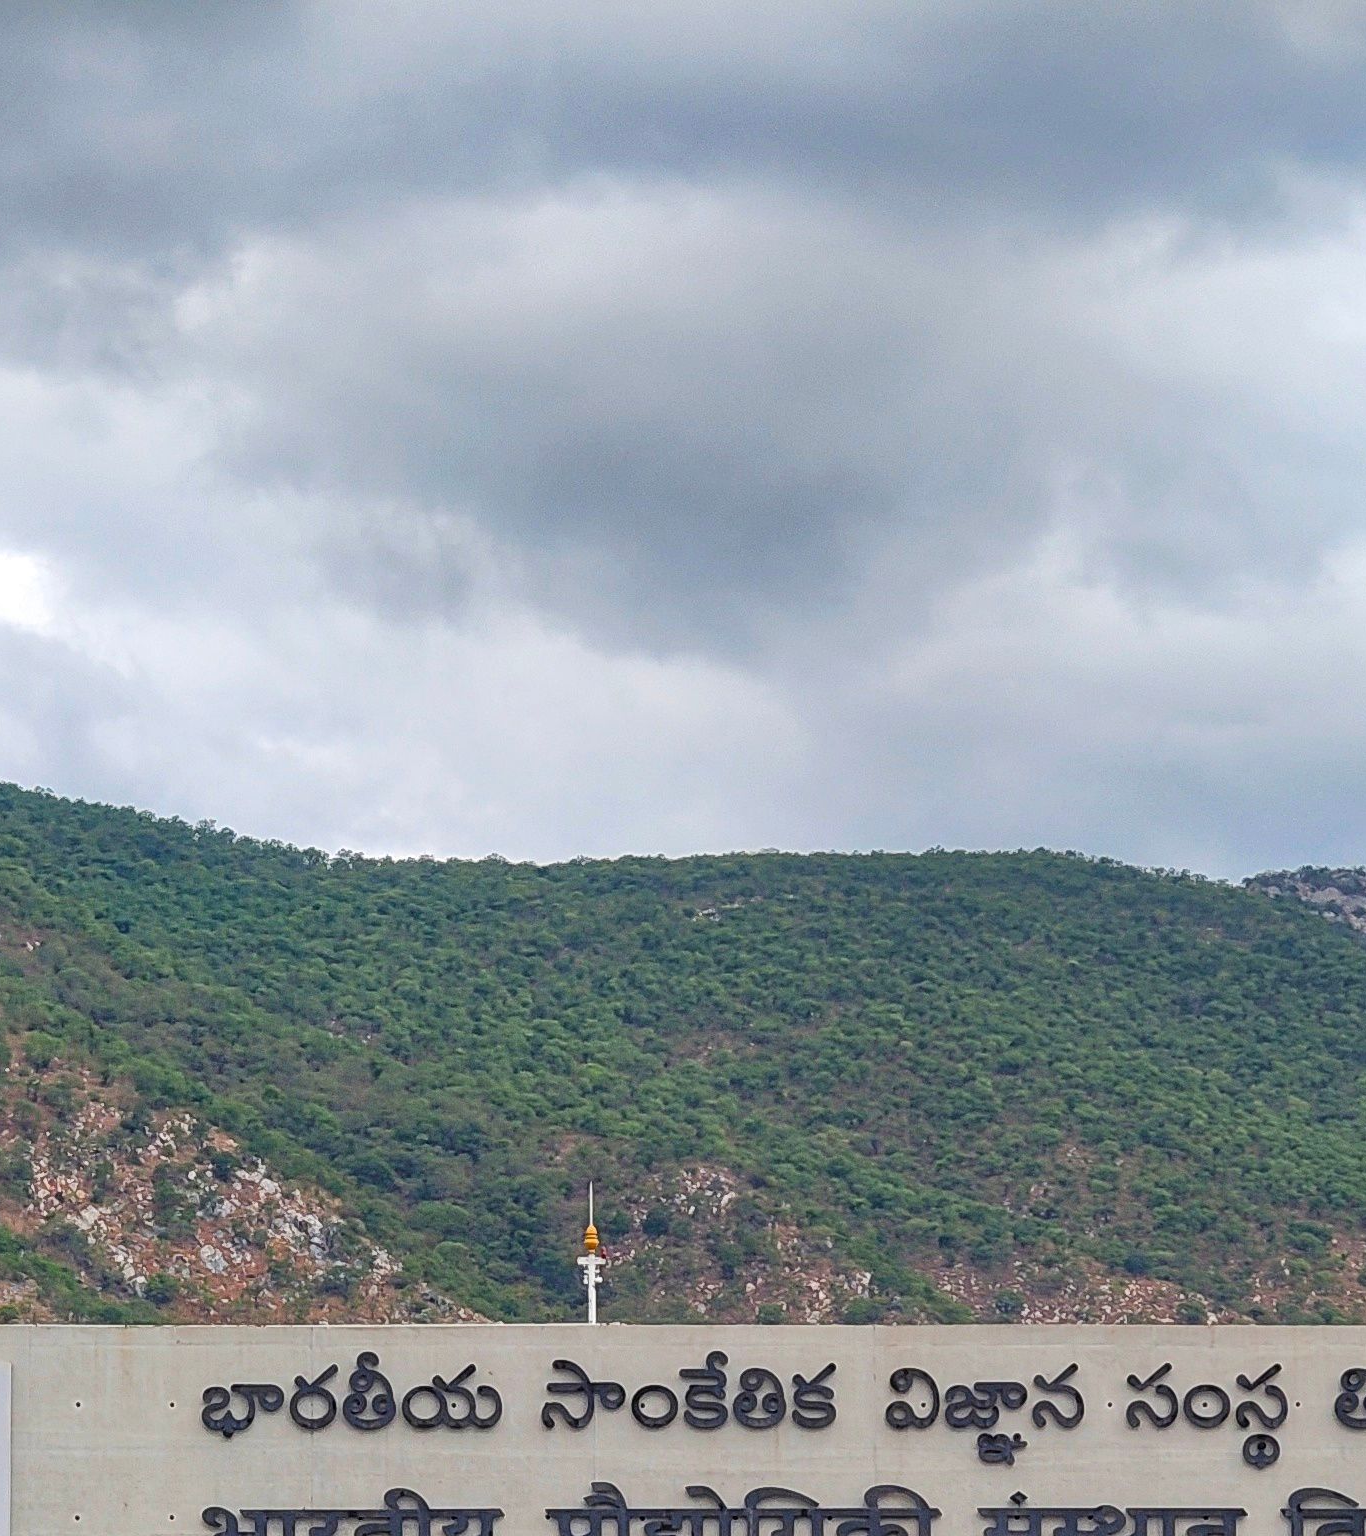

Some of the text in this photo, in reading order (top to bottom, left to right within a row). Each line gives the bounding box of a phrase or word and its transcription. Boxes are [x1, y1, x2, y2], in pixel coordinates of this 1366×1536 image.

[202, 1352, 502, 1440] భారతీయ
[541, 1351, 836, 1432] సాంకేతిక
[886, 1363, 1084, 1466] విజ్ఞాన
[1126, 1363, 1288, 1470] సంస్థ
